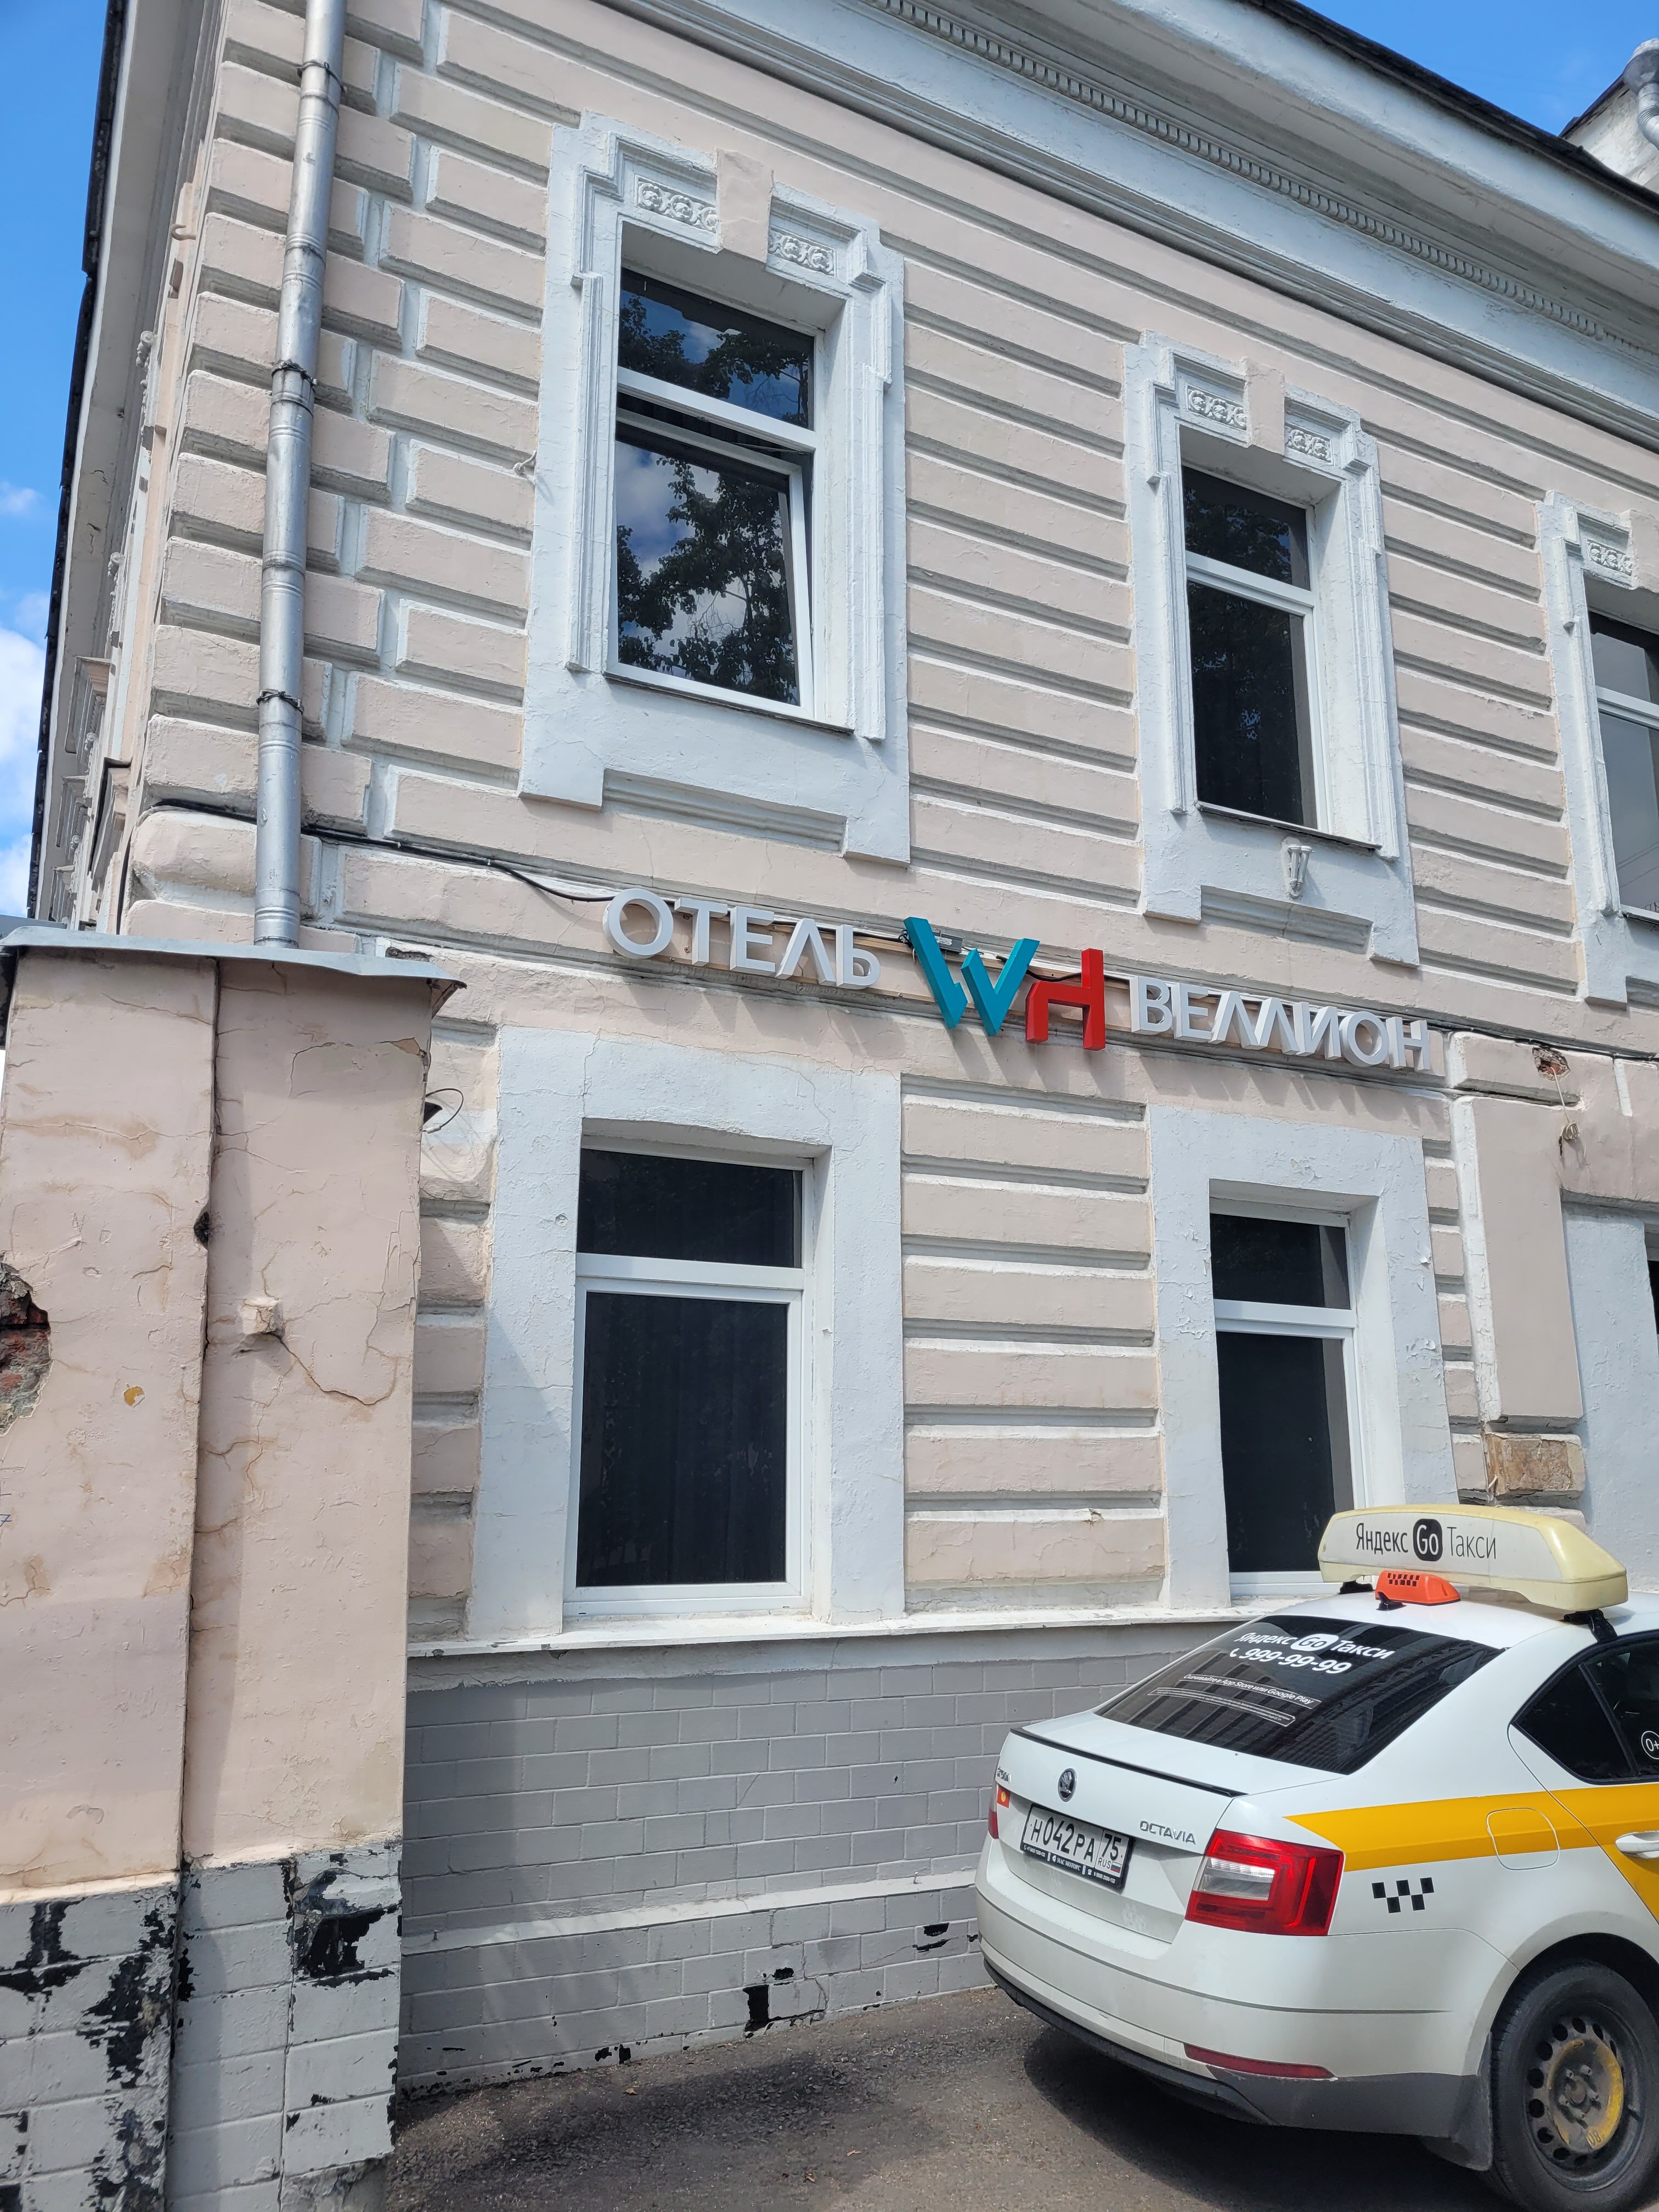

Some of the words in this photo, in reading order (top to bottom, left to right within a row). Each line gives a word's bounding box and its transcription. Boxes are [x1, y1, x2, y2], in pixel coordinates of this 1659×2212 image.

[603, 888, 881, 989] ОТЕЛЬ
[1129, 975, 1431, 1072] ВЕЛЛИОН
[1356, 1522, 1408, 1555] Яндекс
[1416, 1522, 1440, 1556] Go
[1447, 1527, 1497, 1560] Такси
[1234, 1633, 1299, 1645] Яндекс
[1330, 1640, 1396, 1660] Такси
[1239, 1649, 1352, 1674] 999-99-99
[1267, 1688, 1295, 1701] Google
[1294, 1694, 1314, 1705] Play
[1139, 1820, 1196, 1844] OCTAVIA
[1102, 1833, 1122, 1861] 75
[1097, 1857, 1111, 1870] RUS
